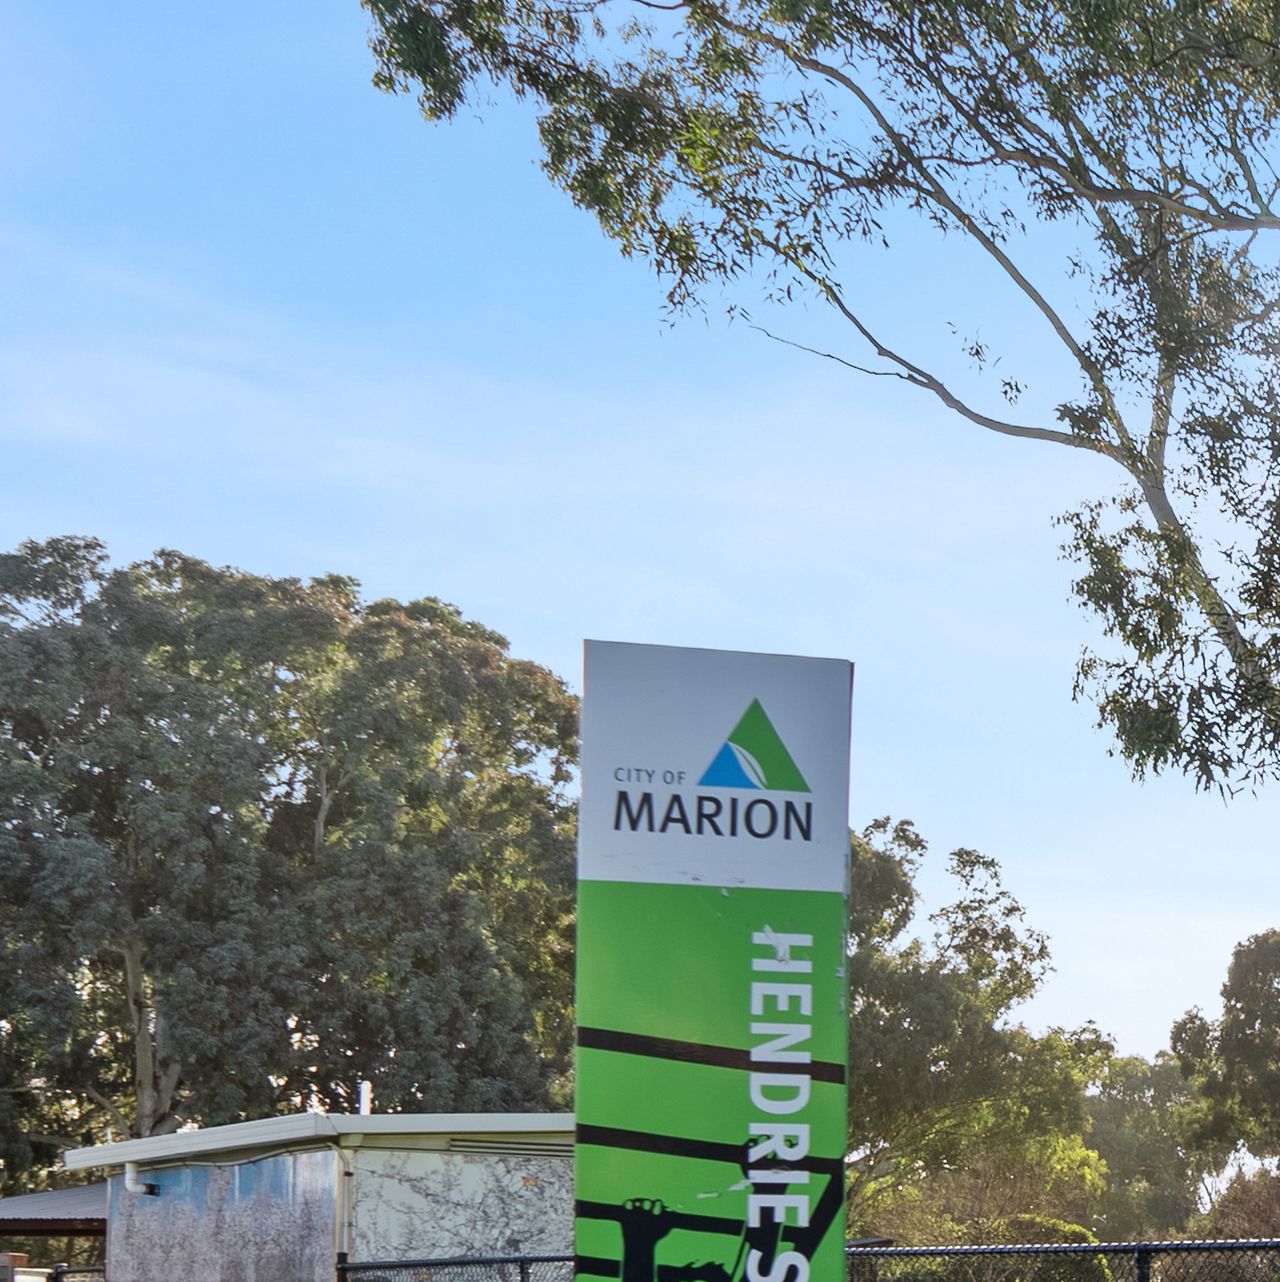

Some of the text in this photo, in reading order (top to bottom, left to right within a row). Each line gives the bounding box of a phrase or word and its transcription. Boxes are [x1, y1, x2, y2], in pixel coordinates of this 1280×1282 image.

[614, 767, 686, 785] CITY OF
[613, 790, 812, 842] MARION
[747, 931, 813, 1228] HENDRIE
